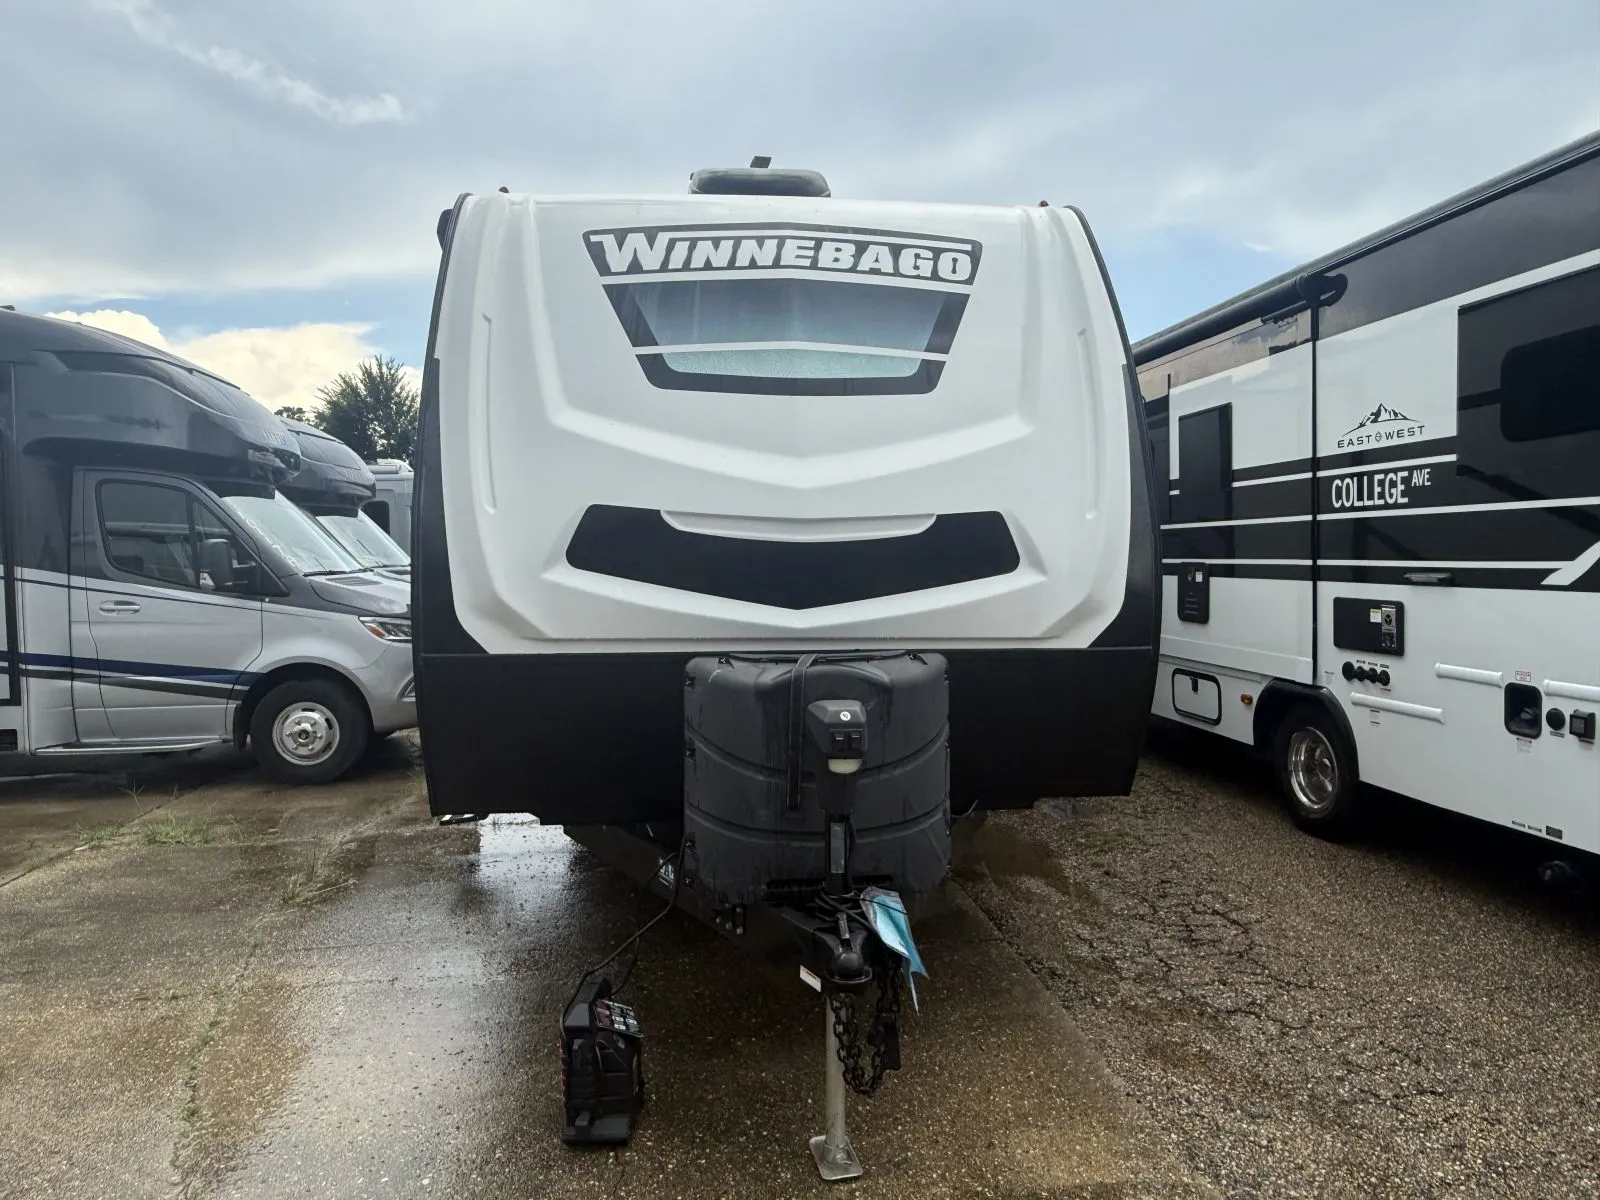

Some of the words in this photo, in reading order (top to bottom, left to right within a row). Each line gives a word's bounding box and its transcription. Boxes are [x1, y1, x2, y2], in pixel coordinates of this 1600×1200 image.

[590, 232, 972, 281] WINNEBAGO
[1337, 435, 1372, 448] EAST
[1385, 425, 1425, 440] WEST
[1332, 471, 1408, 508] COLLEGE
[1411, 468, 1432, 487] AVE
